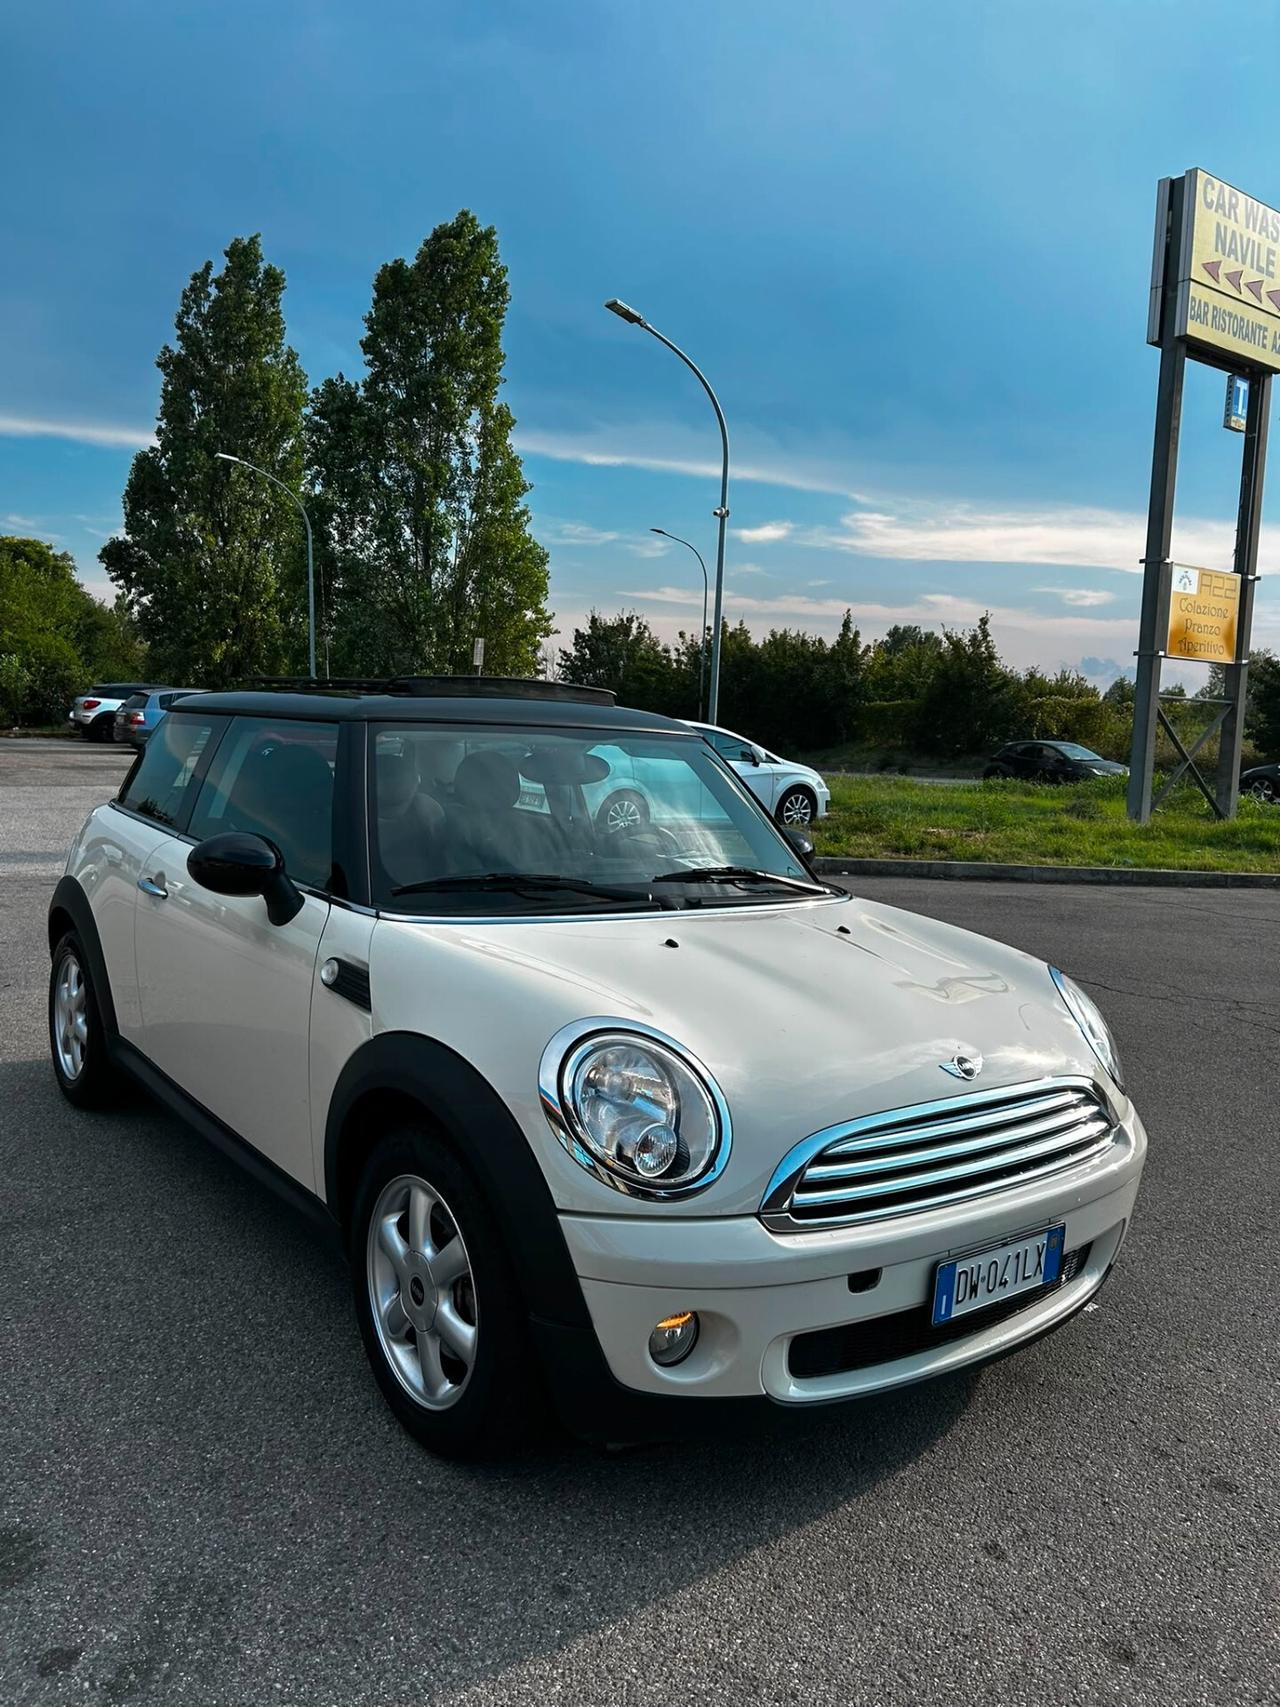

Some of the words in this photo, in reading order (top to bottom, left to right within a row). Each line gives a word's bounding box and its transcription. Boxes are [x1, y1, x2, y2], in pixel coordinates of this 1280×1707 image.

[1203, 177, 1239, 224] CAR
[1215, 221, 1276, 279] NAVILE
[1190, 295, 1209, 326] BAR
[1211, 305, 1268, 350] RISTORANTE
[1179, 597, 1229, 619] Colazione
[1184, 618, 1221, 636] Pranzo
[1178, 637, 1225, 656] Aperitivo
